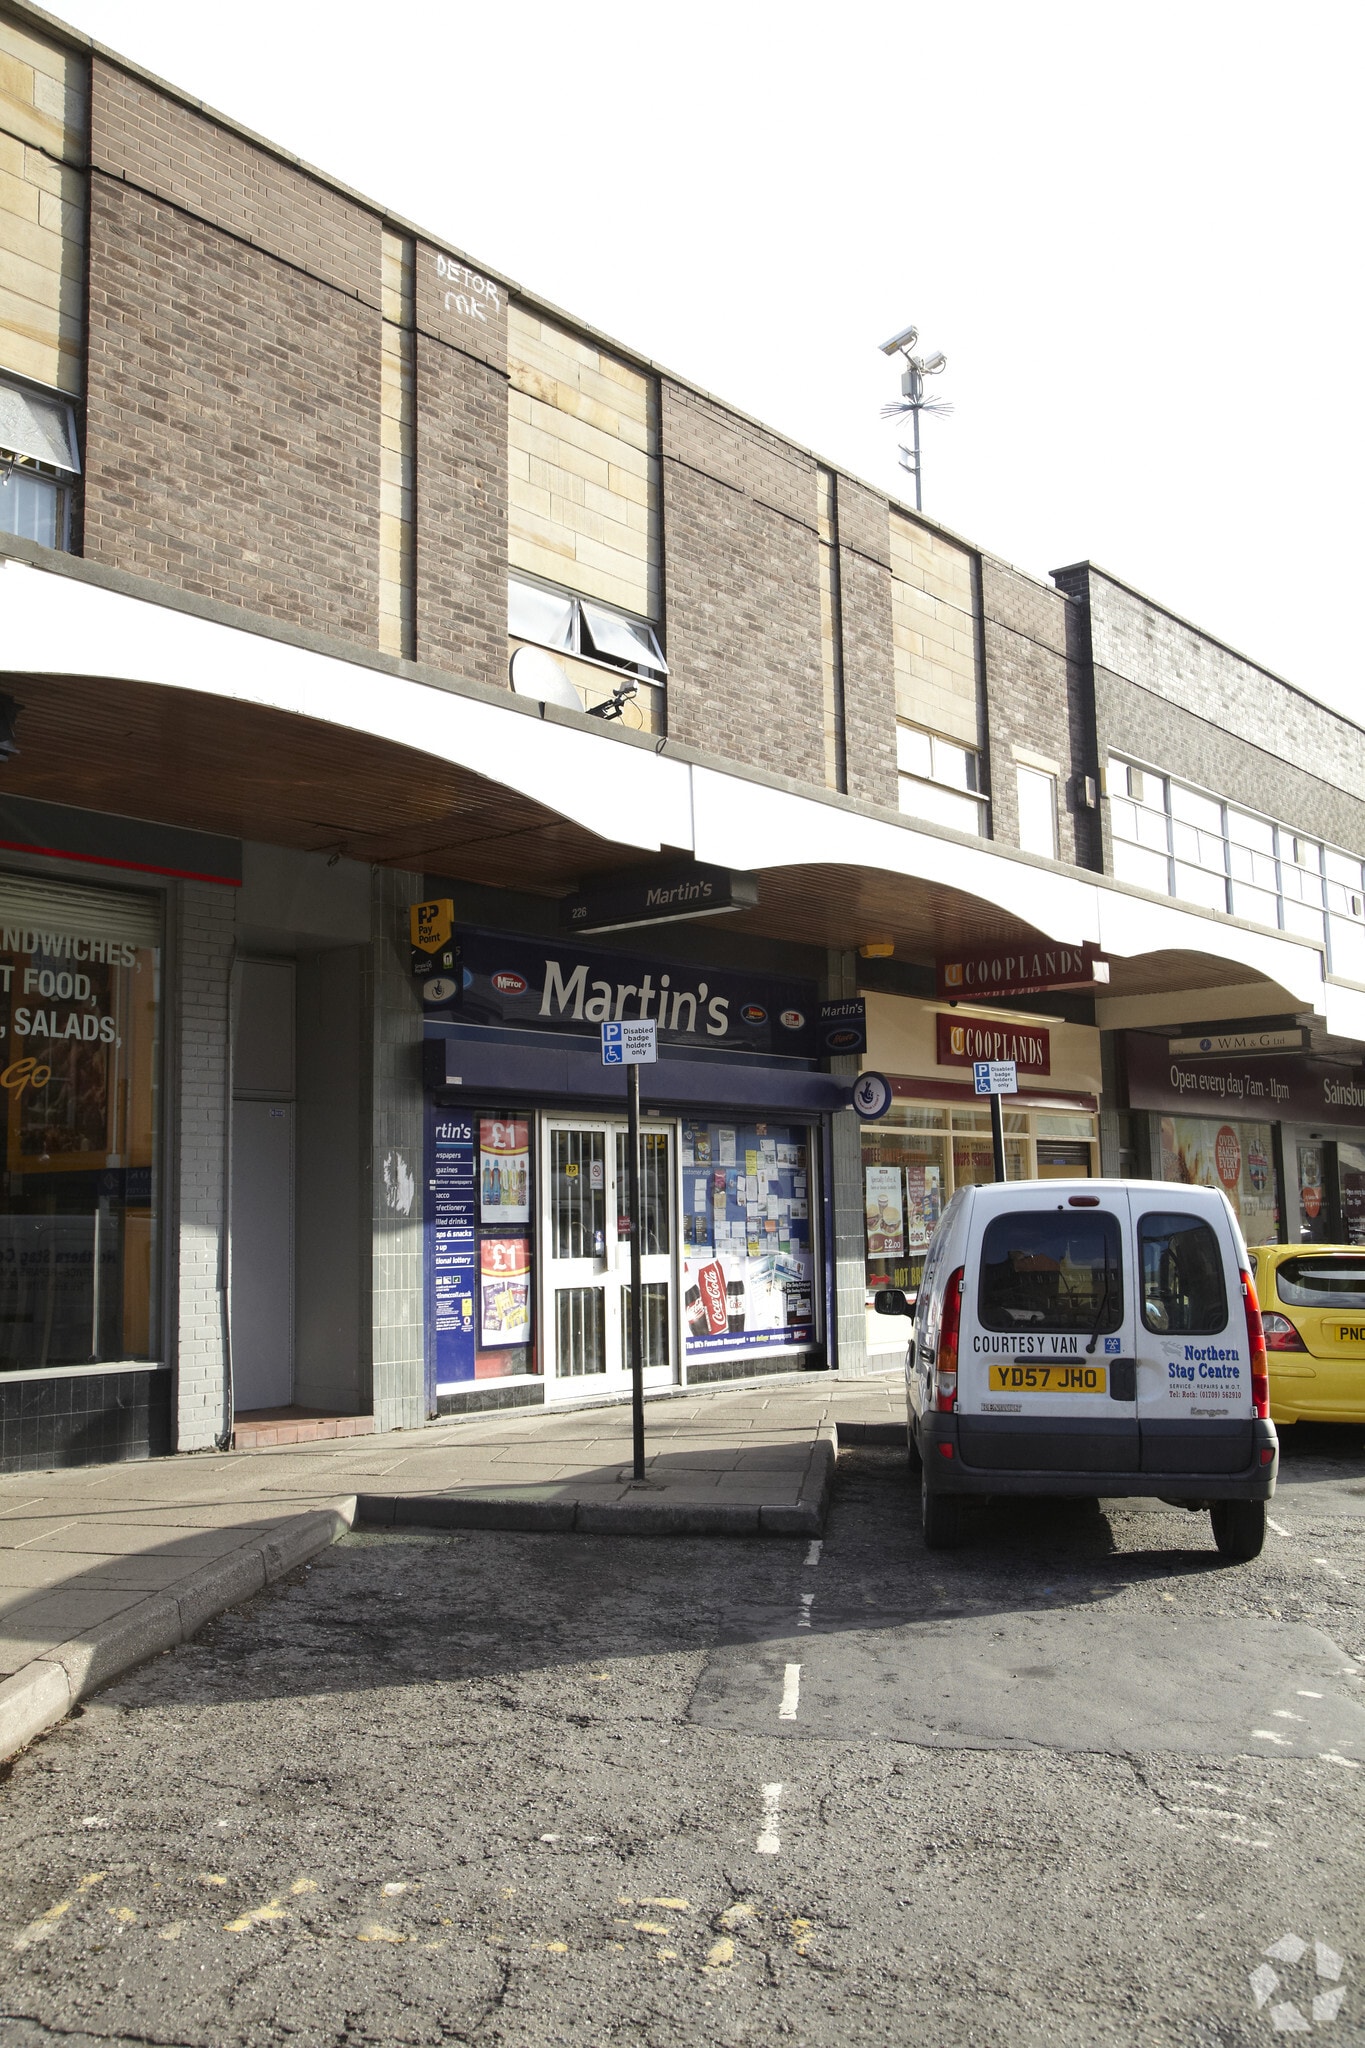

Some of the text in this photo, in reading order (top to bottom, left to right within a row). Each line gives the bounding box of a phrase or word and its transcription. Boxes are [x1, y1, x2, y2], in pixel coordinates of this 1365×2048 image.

[572, 881, 712, 918] 226 Martin's
[419, 925, 433, 936] Pay
[419, 934, 440, 944] Point
[0, 927, 142, 973] NDWICHES,
[965, 950, 1083, 984] COOPLANDS
[23, 968, 97, 1007] FOOD,
[497, 976, 522, 989] Mirror
[538, 960, 730, 1036] Martin's
[821, 1003, 864, 1017] Martin's
[14, 1008, 122, 1048] SALADS,
[966, 1028, 1043, 1066] COOPLANDS
[1259, 1034, 1270, 1047] G
[1273, 1036, 1285, 1045] Ltd
[1170, 1065, 1198, 1093] Open
[1200, 1073, 1226, 1098] every
[1226, 1072, 1244, 1099] day
[1244, 1075, 1264, 1097] 7am
[1270, 1078, 1290, 1103] 11pm
[492, 1122, 516, 1148] £1
[1218, 1134, 1236, 1146] OVEN
[1218, 1145, 1239, 1158] BAKED
[1219, 1157, 1239, 1168] EVERY
[1223, 1168, 1236, 1180] DAY
[449, 1217, 467, 1225] drinks
[447, 1230, 452, 1238] &
[884, 1237, 901, 1249] £2.00
[453, 1256, 471, 1265] lottery
[492, 1243, 516, 1270] £1
[894, 1267, 909, 1288] HOT
[973, 1335, 1078, 1353] COURTESY VAN
[1184, 1345, 1240, 1361] Northern
[998, 1367, 1051, 1387] YD57
[1168, 1362, 1240, 1381] Stag Centre
[1169, 1390, 1242, 1399] Tel: Roth: (01709) 562910
[981, 1402, 1022, 1413] RENAULT
